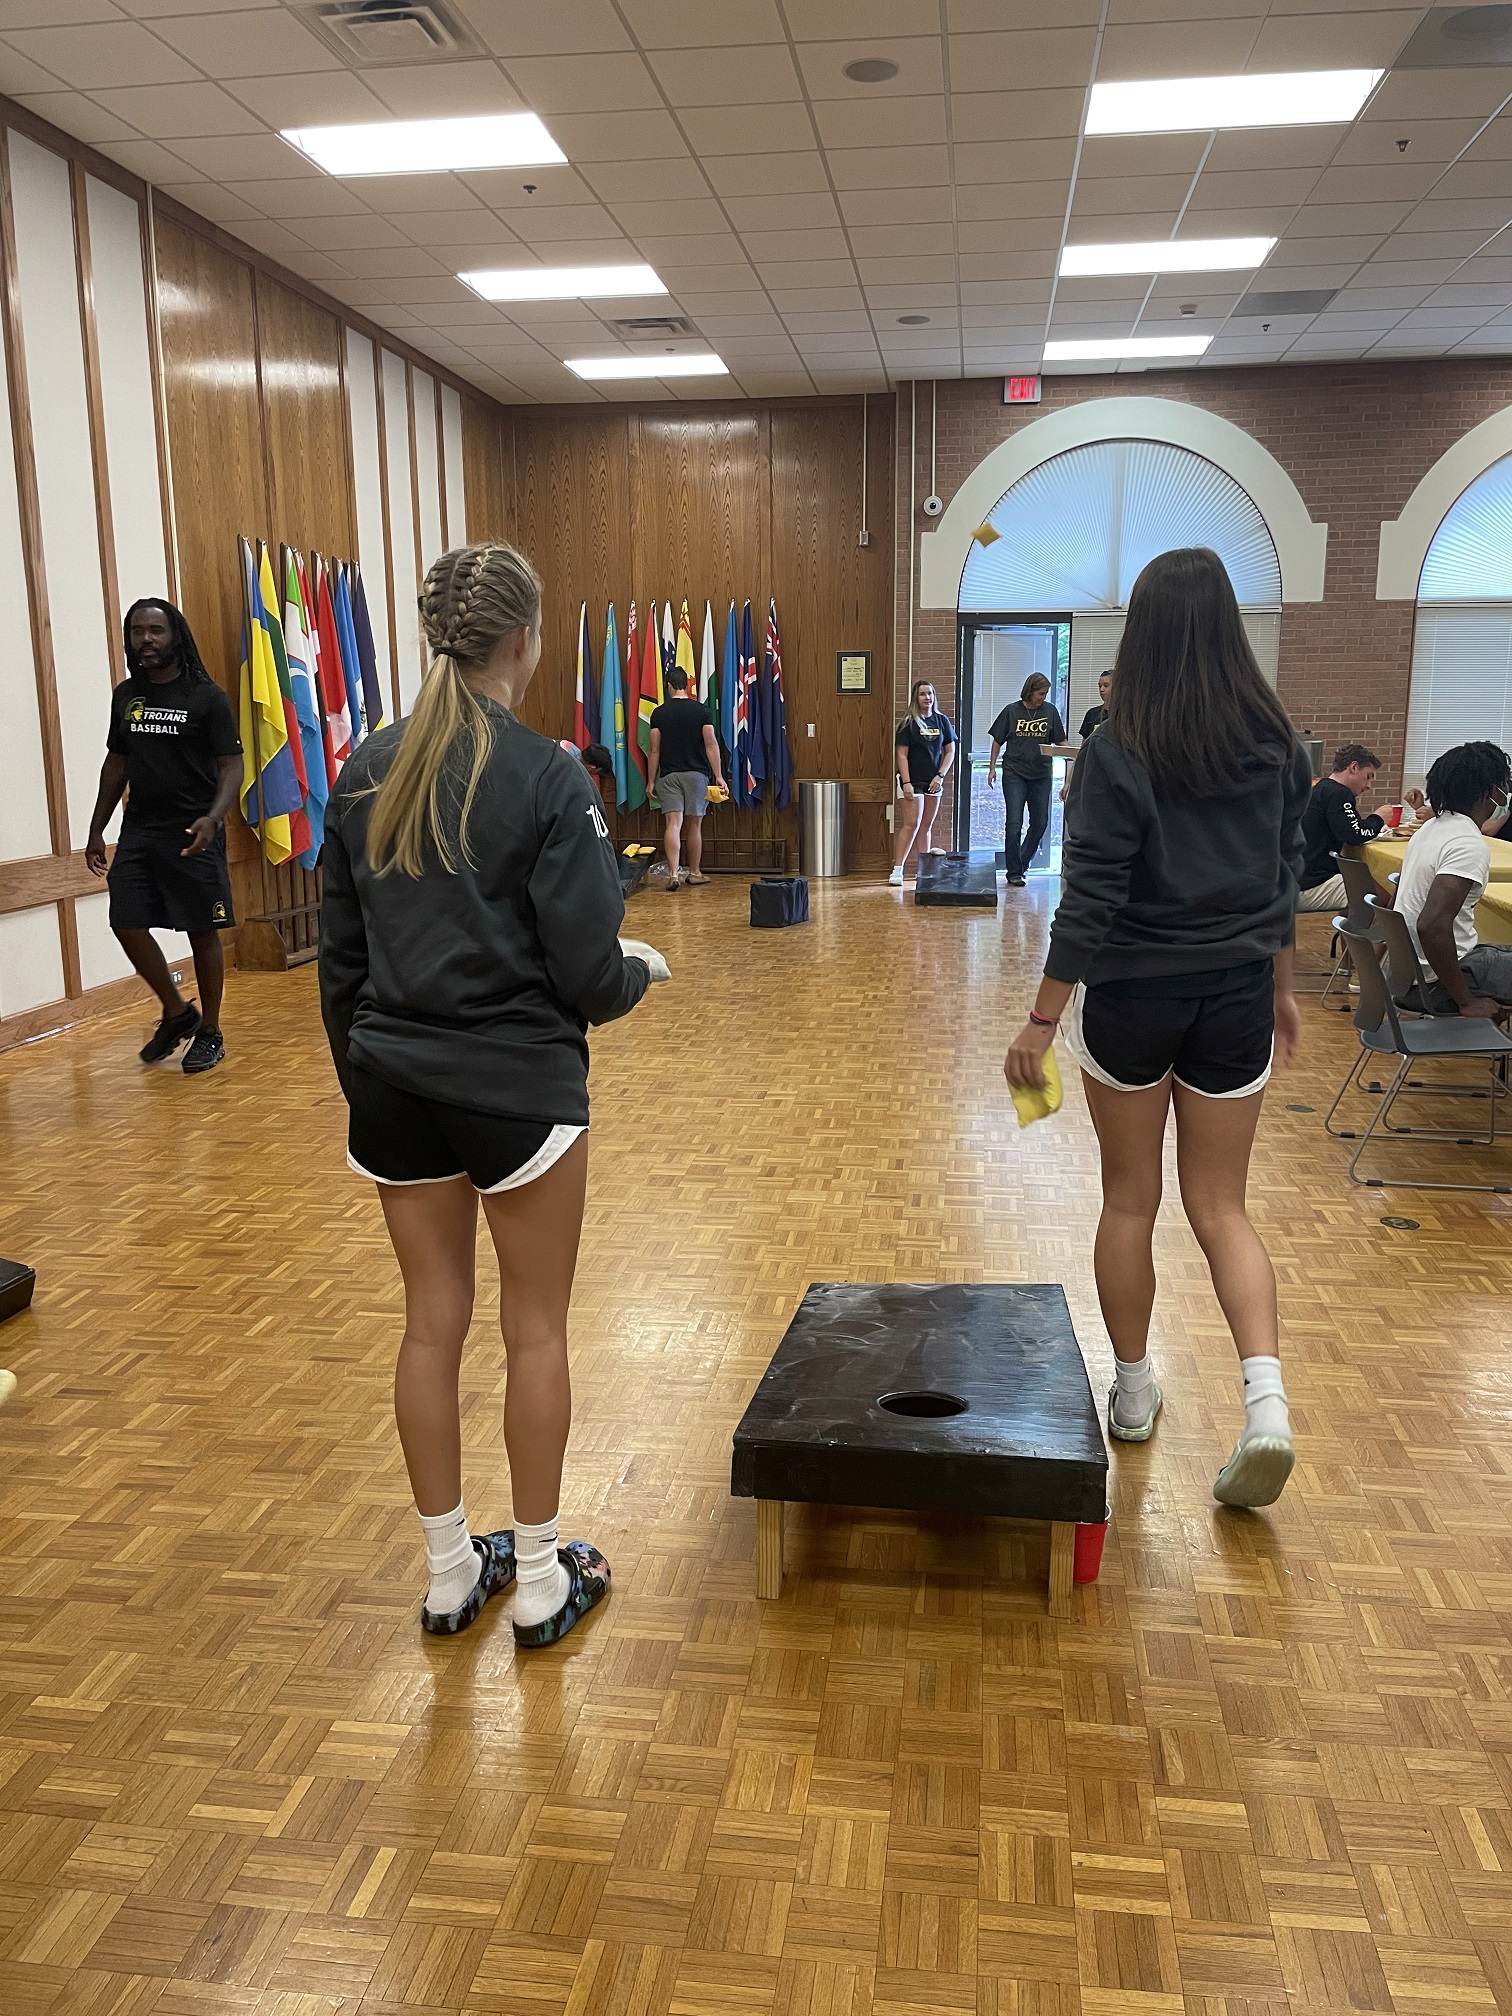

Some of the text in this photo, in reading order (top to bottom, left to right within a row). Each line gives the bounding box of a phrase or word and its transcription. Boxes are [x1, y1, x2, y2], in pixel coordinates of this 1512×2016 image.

[1009, 377, 1038, 400] EXIT
[143, 711, 188, 723] TROJANS
[130, 723, 179, 735] BASEBALL
[1015, 718, 1048, 732] FTCC
[1343, 802, 1356, 818] OFF
[585, 804, 609, 838] 10
